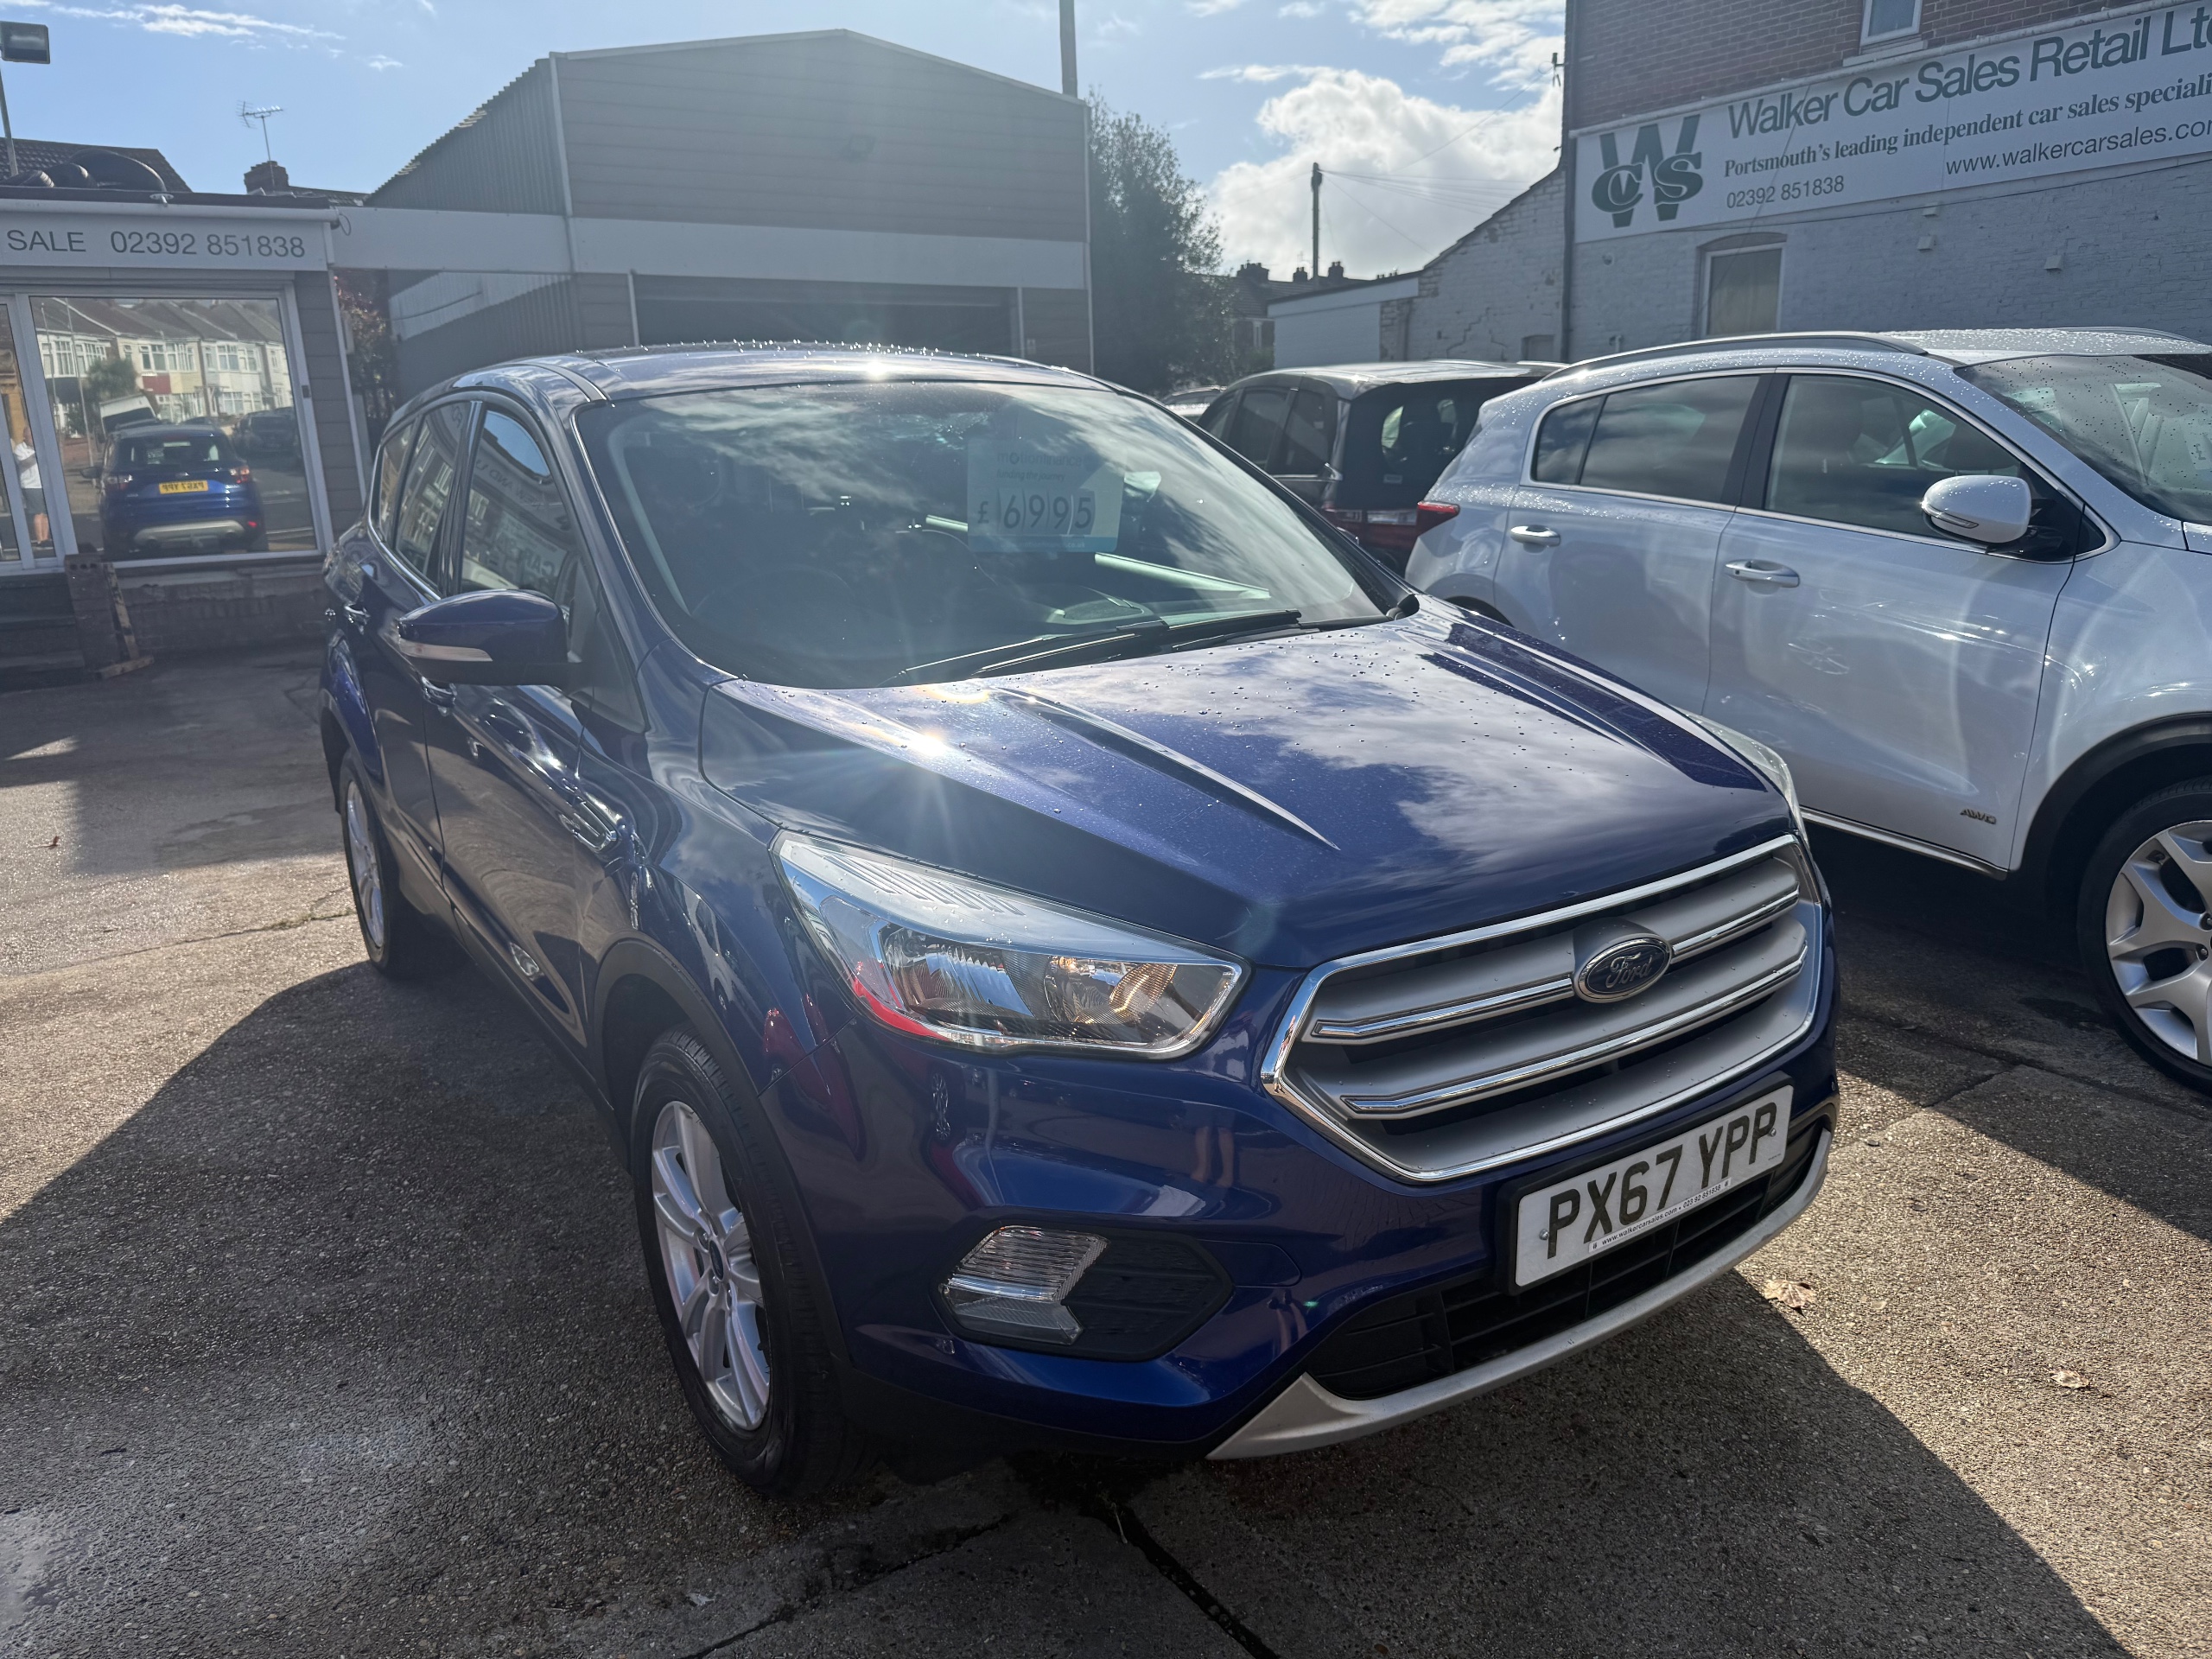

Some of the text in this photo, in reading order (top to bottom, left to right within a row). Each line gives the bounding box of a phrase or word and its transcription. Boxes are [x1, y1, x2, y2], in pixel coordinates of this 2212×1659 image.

[1728, 6, 2212, 139] Walker Car Sales Retail Lt
[1834, 134, 1898, 159] leading
[1903, 109, 2024, 148] independent
[2028, 105, 2063, 126] car
[2067, 93, 2120, 119] sales
[1945, 119, 2212, 175] www.walkercarsales.co
[1726, 175, 1845, 209] 02392 851838
[6, 229, 306, 258] SALE 02392 851838
[1960, 808, 1998, 825] AWD
[1605, 951, 1654, 989] Ford
[1547, 1102, 1777, 1260] PX67 YPP
[1601, 1206, 1678, 1246] www.walkercarsales.com
[1682, 1198, 1694, 1210] 023
[1701, 1184, 1721, 1199] 851838
